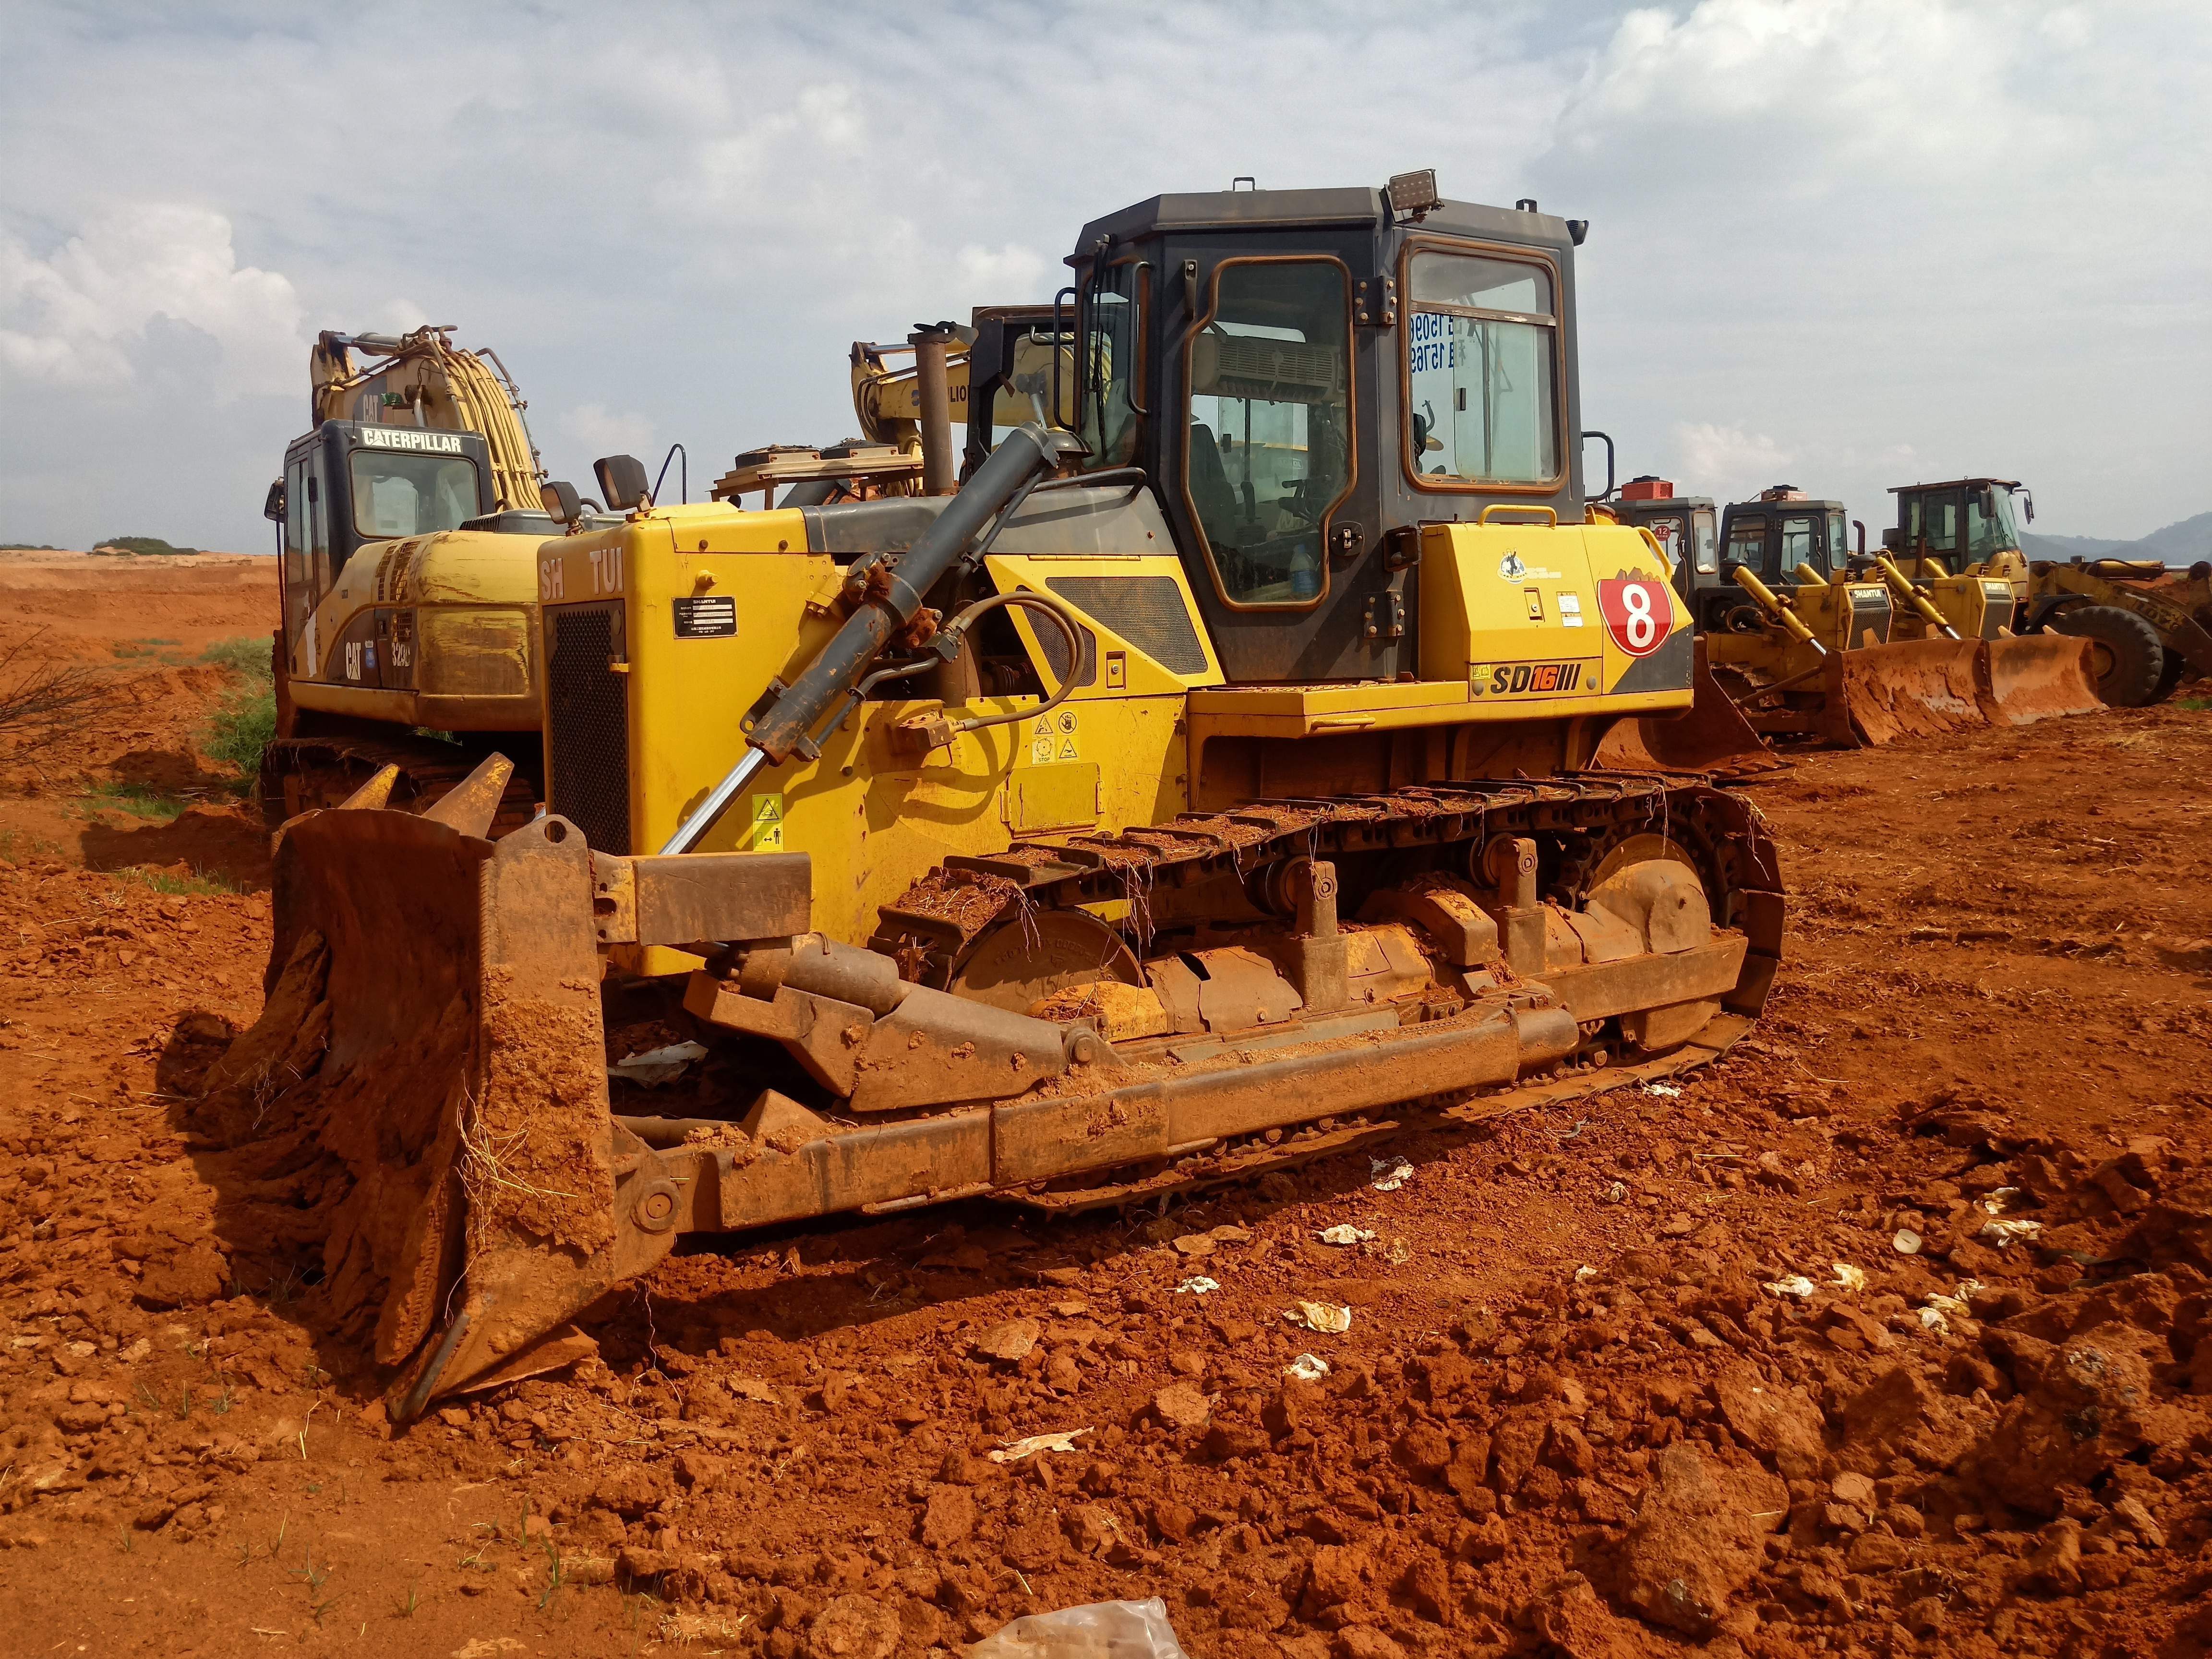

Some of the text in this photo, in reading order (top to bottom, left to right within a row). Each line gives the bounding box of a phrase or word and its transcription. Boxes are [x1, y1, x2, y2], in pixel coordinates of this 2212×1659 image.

[363, 394, 378, 422] CAT
[363, 430, 461, 453] CATERPILLAR
[1854, 589, 1882, 599] SHANTUI
[1622, 584, 1655, 648] 8
[346, 642, 361, 680] CAT
